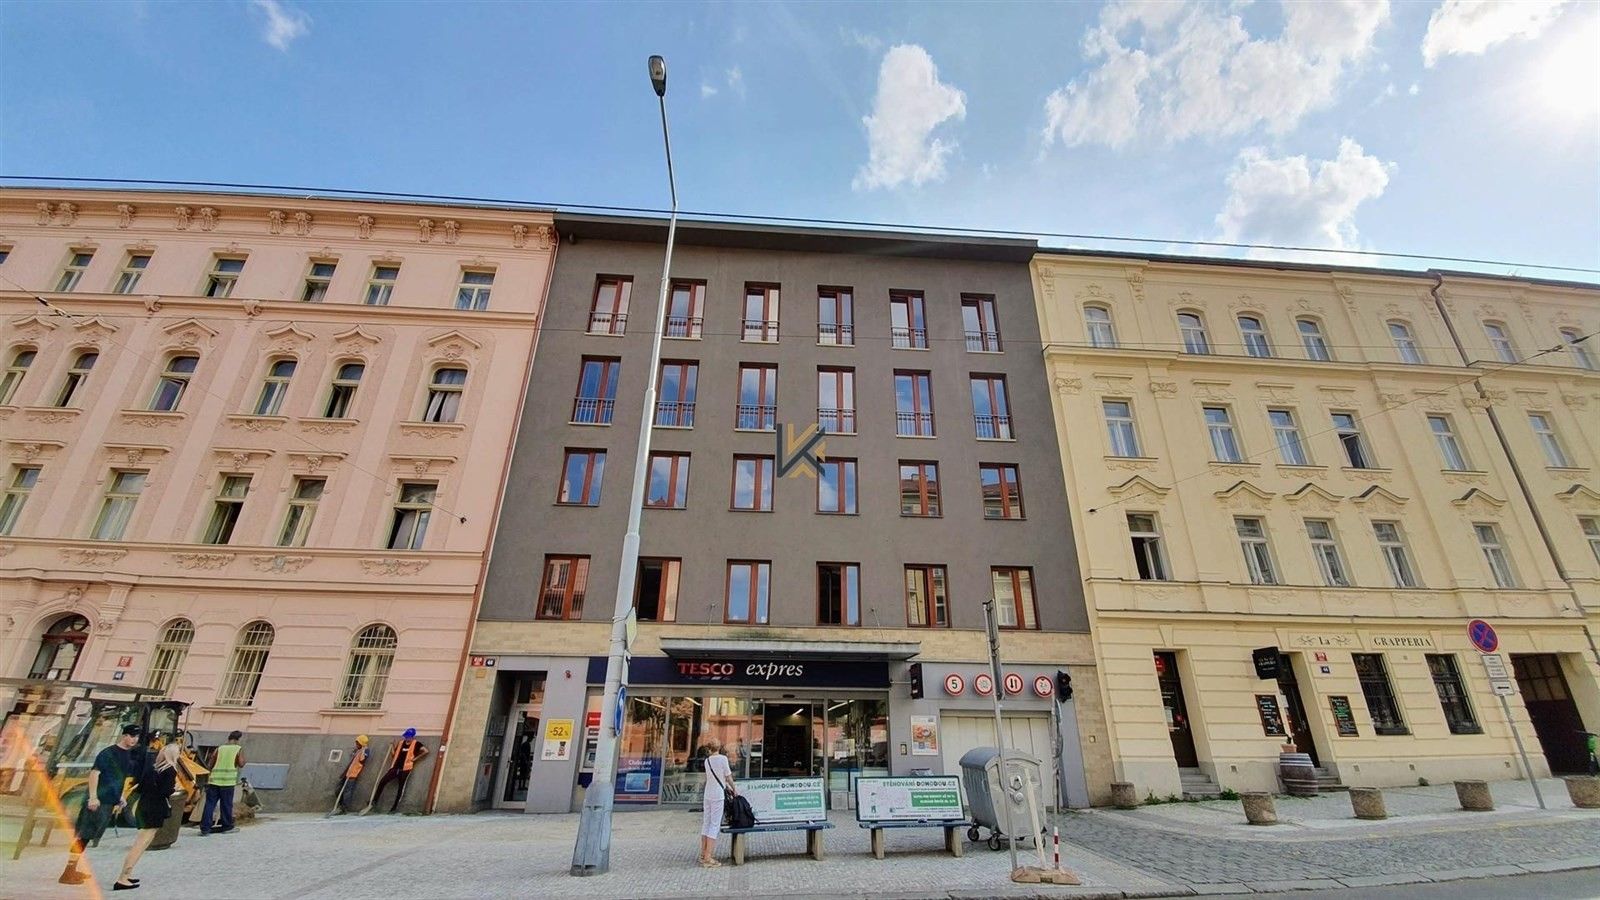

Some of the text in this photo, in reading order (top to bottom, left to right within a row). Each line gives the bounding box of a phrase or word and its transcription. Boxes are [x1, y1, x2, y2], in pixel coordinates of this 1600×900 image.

[1318, 636, 1432, 647] La GRAPPERIA
[677, 662, 804, 680] TESCO expres
[951, 679, 958, 689] 5
[549, 726, 564, 736] -52
